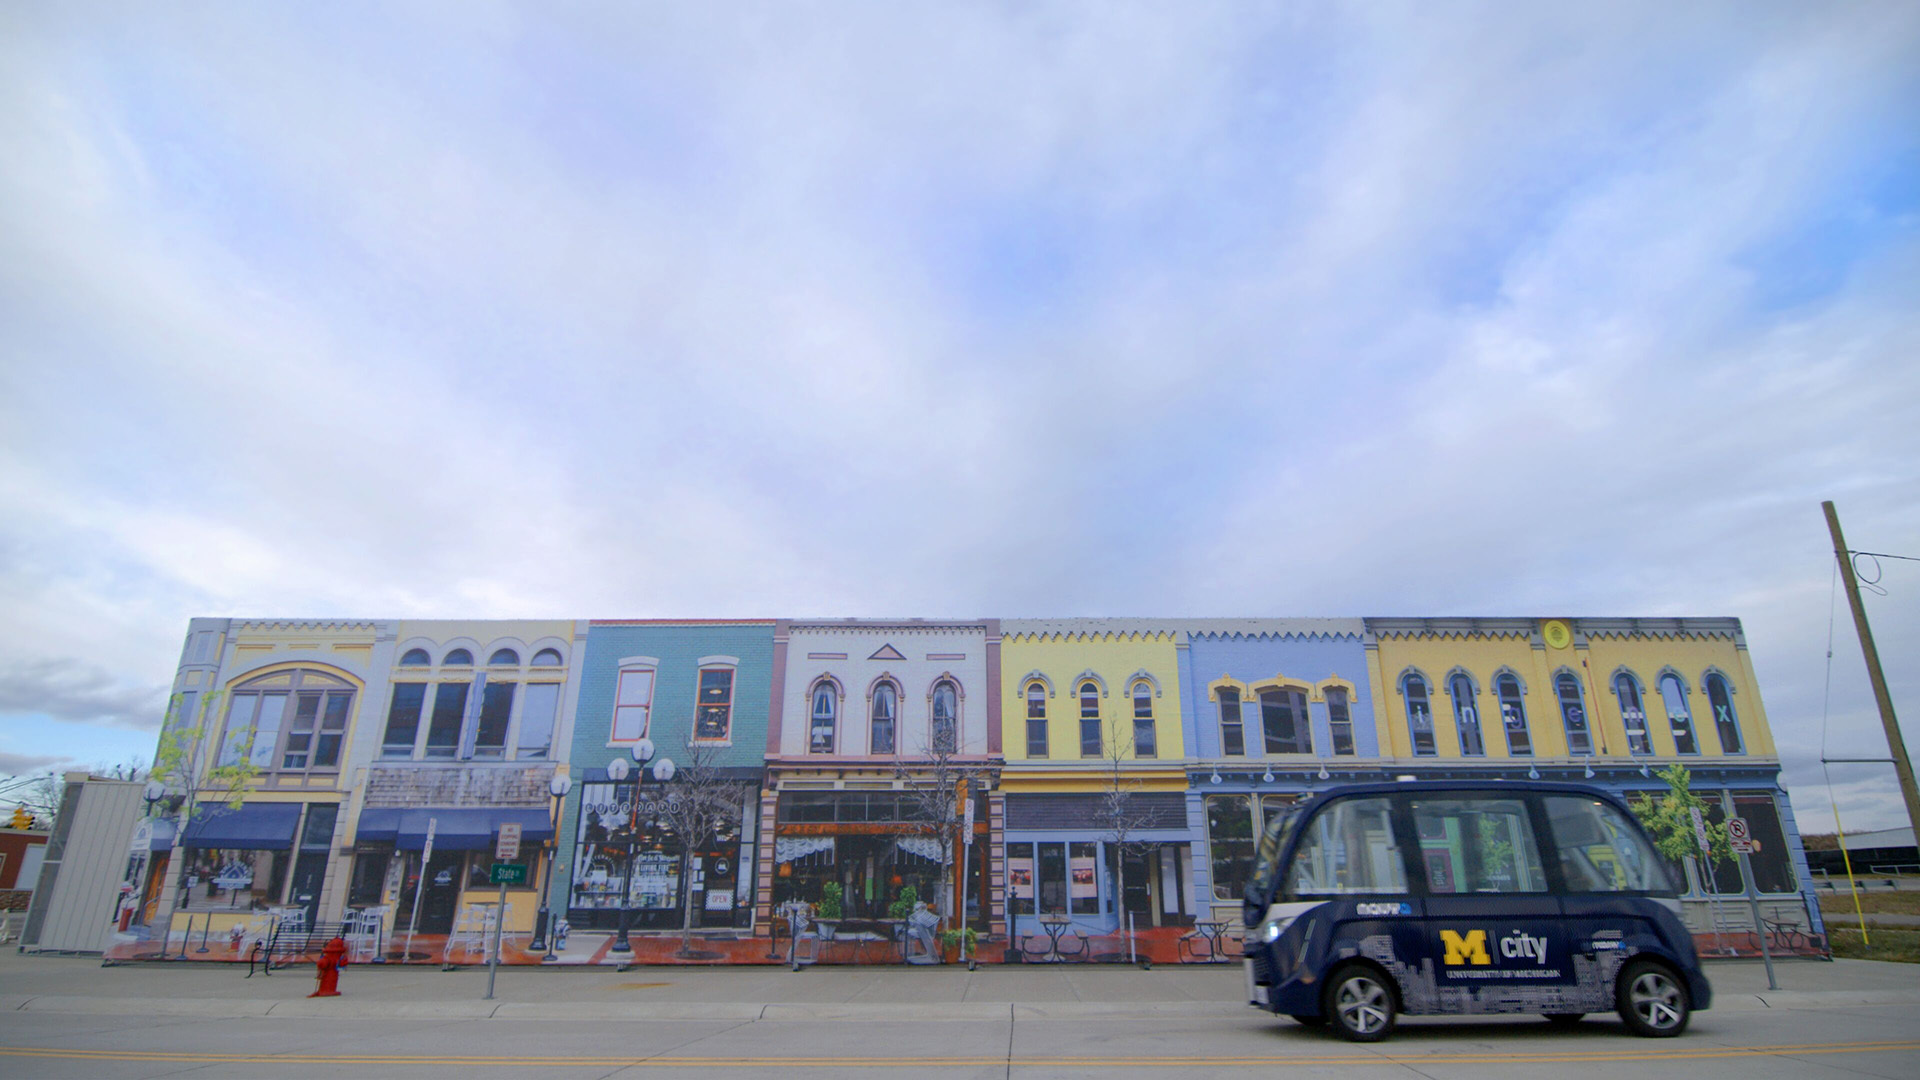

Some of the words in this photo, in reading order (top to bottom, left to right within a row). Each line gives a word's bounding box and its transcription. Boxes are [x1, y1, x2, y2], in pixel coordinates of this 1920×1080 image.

[497, 868, 515, 880] State
[711, 895, 727, 904] OPEN
[1439, 929, 1492, 966] M
[1500, 929, 1548, 965] city
